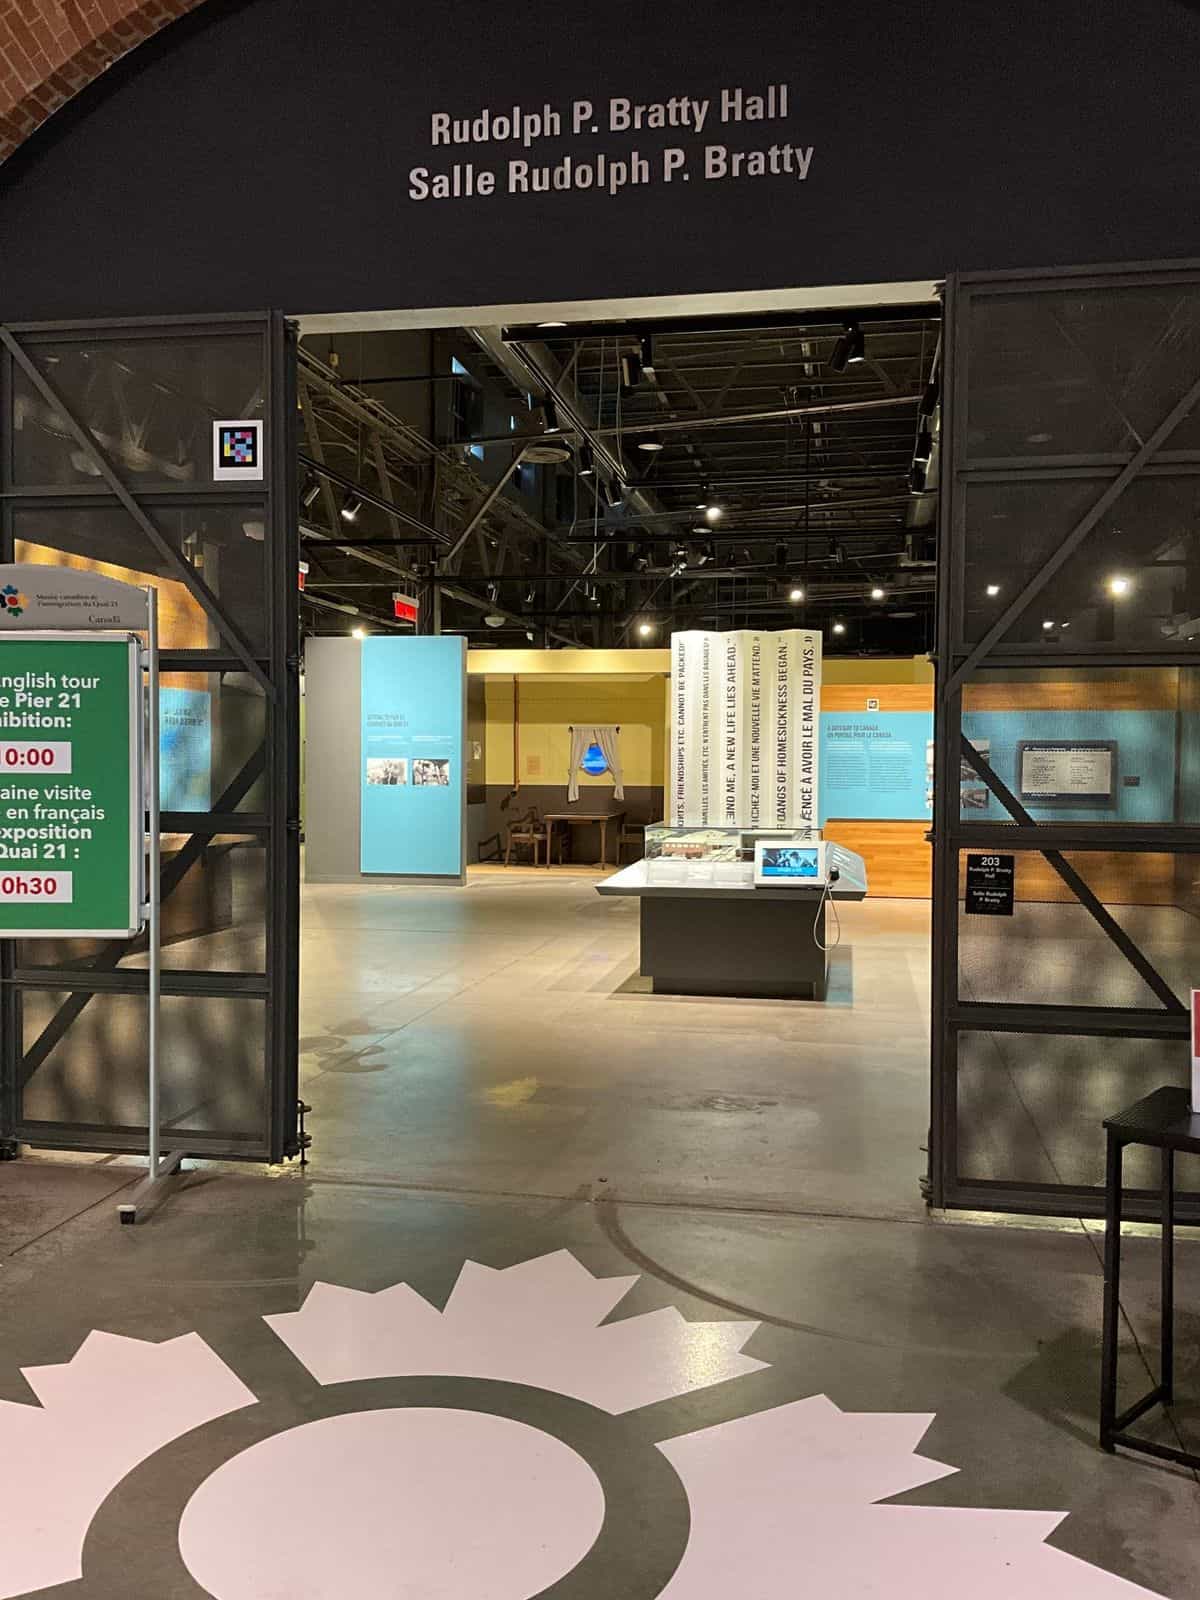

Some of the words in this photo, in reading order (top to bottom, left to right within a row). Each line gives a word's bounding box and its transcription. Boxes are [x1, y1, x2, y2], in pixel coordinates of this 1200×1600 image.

[431, 104, 561, 147] Rudolph
[573, 100, 599, 134] P.
[609, 96, 710, 133] Bratty
[720, 84, 788, 123] Hall
[408, 164, 497, 201] Salle
[508, 151, 650, 195] Rudolph
[663, 147, 690, 182] P.
[704, 143, 815, 180] Bratty
[0, 672, 56, 691] nglish
[61, 675, 100, 689] tour
[679, 680, 685, 690] BE
[803, 680, 813, 694] DU
[15, 692, 53, 708] Pier
[58, 693, 81, 708] 21
[727, 686, 736, 708] LIES
[752, 688, 760, 700] VIE
[802, 697, 813, 721] MAL
[727, 712, 735, 733] LIFE
[752, 702, 760, 743] NOUVELLE
[777, 684, 787, 767] HOMESICKNESS
[802, 725, 813, 737] LE
[726, 736, 735, 760] NEW
[752, 745, 760, 761] UNE
[802, 741, 813, 774] AVOIR
[752, 765, 760, 773] ET
[777, 769, 786, 783] OF
[44, 785, 92, 800] visite
[6, 808, 28, 820] en
[33, 804, 105, 824] français
[43, 844, 66, 859] 21
[981, 857, 1000, 866] 203
